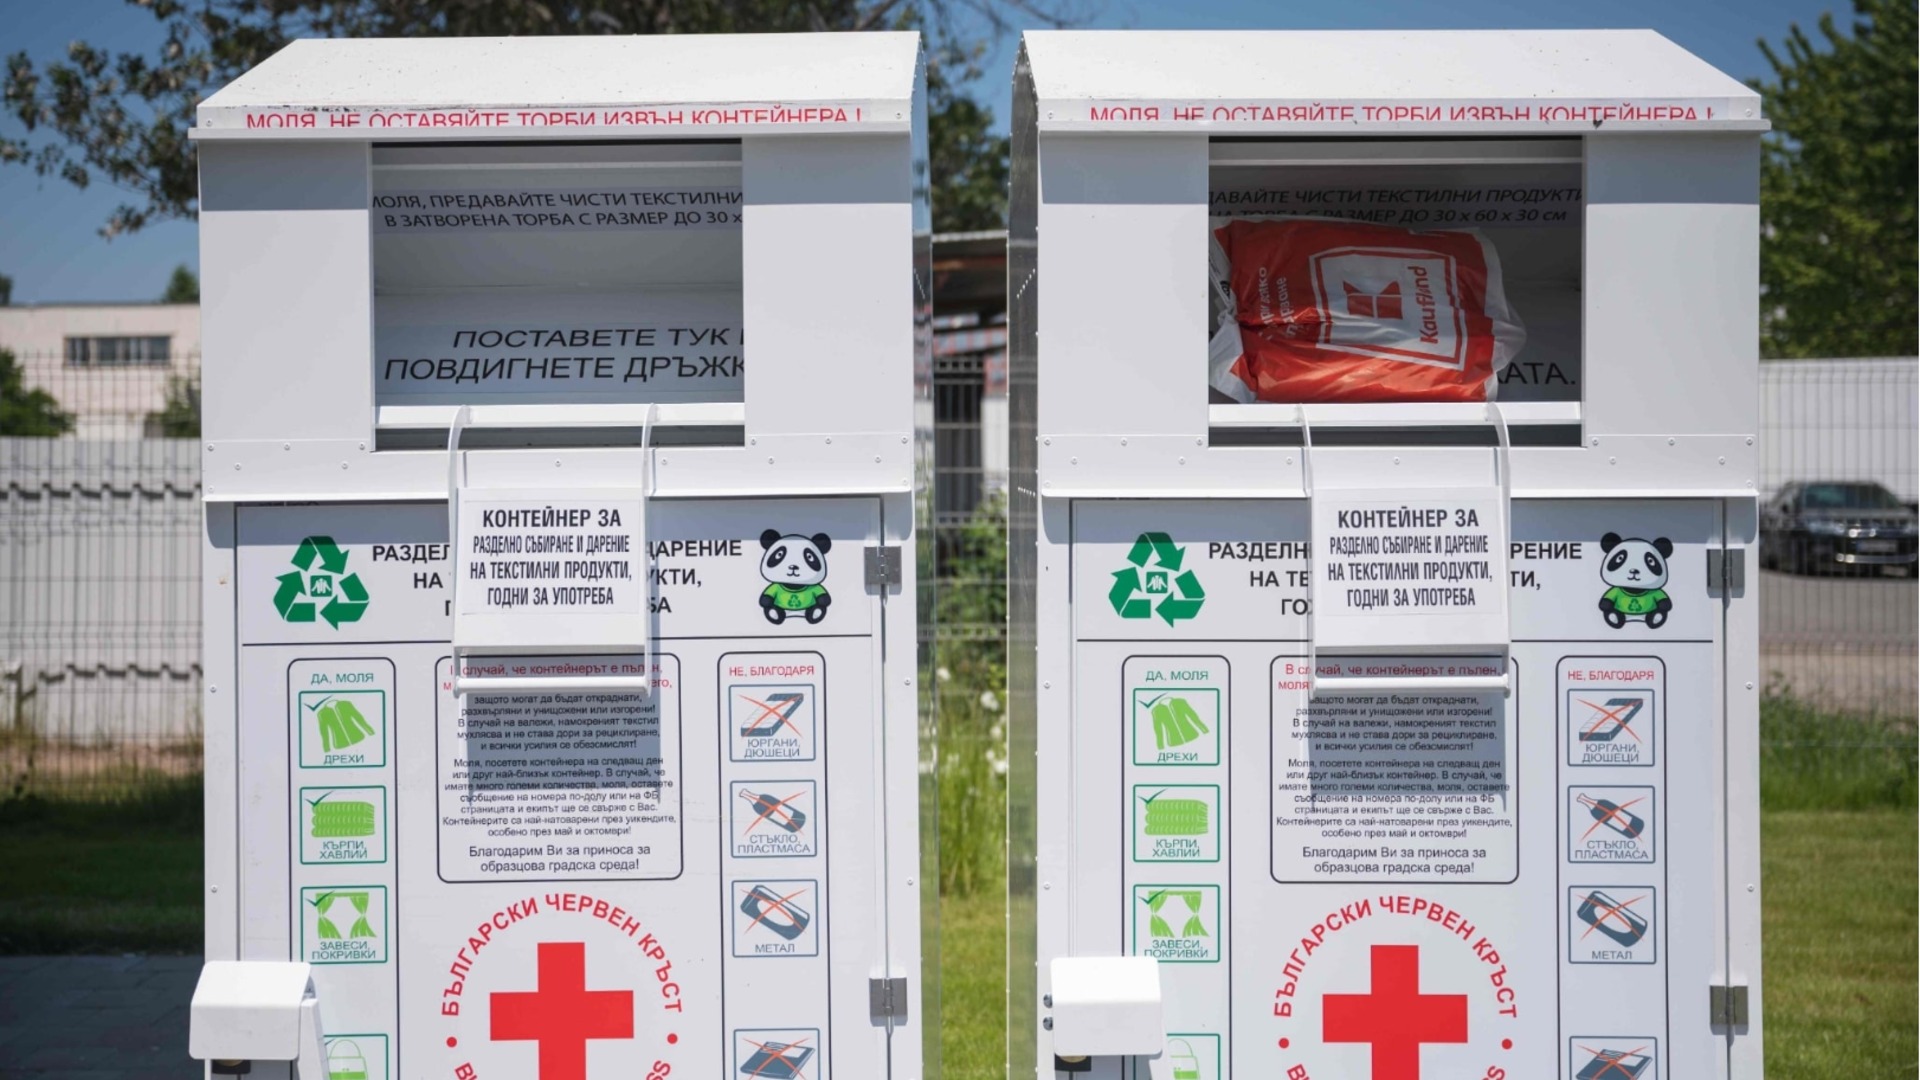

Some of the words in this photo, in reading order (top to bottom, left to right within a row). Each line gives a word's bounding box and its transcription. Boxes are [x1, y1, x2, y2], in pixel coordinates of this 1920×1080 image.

[431, 192, 554, 210] ПРЕДАВАЙТЕ
[562, 193, 626, 206] ЧИСТИ
[1295, 190, 1361, 204] ЧИСТИ
[1367, 189, 1482, 204] ТЕКСТИЛНИ
[386, 215, 396, 227] В
[402, 214, 509, 227] ЗАТВОРЕНА
[516, 213, 575, 226] ТОРБА
[580, 212, 592, 225] С
[596, 212, 668, 225] РАЗМЕР
[674, 212, 701, 226] ДО
[707, 212, 728, 224] 30
[1398, 208, 1430, 224] ДО
[1434, 209, 1456, 222] 30
[1476, 209, 1498, 222] 60
[1517, 209, 1538, 222] 30
[453, 329, 656, 348] ПОСТАВЕТЕ
[668, 328, 730, 346] ТУК
[384, 357, 615, 384] ПОВДИГНЕТЕ
[482, 506, 591, 528] КОНТЕЙНЕР
[598, 509, 622, 527] ЗА
[1338, 506, 1448, 528] КОНТЕЙНЕР
[1455, 509, 1479, 528] ЗА
[473, 536, 522, 556] РАЗДЕЛНО
[524, 535, 574, 553] СЪБИРАНЕ
[577, 535, 584, 552] И
[586, 535, 630, 554] ДАРЕНИЕ
[1330, 536, 1379, 558] РАЗДЕЛНО
[1382, 536, 1432, 554] СЪБИРАНЕ
[1435, 536, 1442, 552] И
[1444, 535, 1488, 555] ДАРЕНИЕ
[470, 562, 486, 580] НА
[490, 561, 560, 580] ТЕКСТИЛНИ
[564, 560, 632, 582] ПРОДУКТИ,
[1328, 564, 1344, 581] НА
[1348, 562, 1420, 581] ТЕКСТИЛНИ
[1424, 561, 1492, 582] ПРОДУКТИ,
[413, 572, 444, 589] НА
[1250, 571, 1280, 588] НА
[488, 588, 528, 608] ГОДНИ
[533, 588, 548, 605] ЗА
[553, 586, 614, 606] УПОТРЕБА
[1347, 590, 1390, 610] ГОДНИ
[1393, 588, 1410, 606] ЗА
[1413, 588, 1476, 606] УПОТРЕБА
[622, 664, 663, 674] пълн,
[729, 666, 748, 678] НЕ,
[750, 666, 815, 677] БЛАГОДАРЯ
[336, 672, 374, 683] МОЛЯ
[1170, 670, 1209, 681] МОЛЯ
[1568, 670, 1586, 682] НЕ,
[1588, 670, 1655, 682] БЛАГОДАРЯ
[744, 748, 801, 759] ДЮШЕЦИ
[1586, 743, 1640, 755] ЮРГАНИ,
[324, 754, 364, 766] ДРЕХИ
[1157, 752, 1198, 764] ДРЕХИ
[1582, 752, 1640, 764] ДЮШЕЦИ
[323, 840, 368, 852] КЪРПИ,
[750, 834, 800, 846] СТЪКЛО,
[1156, 838, 1200, 850] КЪРПИ,
[1586, 840, 1639, 852] СТЪКЛО,
[320, 850, 368, 860] ХАВЛИИ
[469, 845, 542, 860] Благодарим
[547, 845, 563, 856] Ви
[566, 848, 580, 856] за
[584, 846, 634, 858] приноса
[638, 846, 650, 856] за
[738, 844, 810, 855] ПЛАСТМАСА
[1152, 848, 1200, 858] ХАВЛИИ
[1302, 846, 1378, 861] Благодарим
[1381, 846, 1398, 858] Ви
[1401, 849, 1414, 858] за
[1418, 849, 1469, 860] приноса
[1472, 849, 1486, 858] за
[1574, 850, 1648, 860] ПЛАСТМАСА
[480, 860, 545, 873] образцова
[549, 860, 596, 872] градска
[600, 859, 640, 872] среда!
[1314, 861, 1380, 875] образцова
[1383, 862, 1431, 874] градска
[1434, 862, 1474, 874] среда!
[320, 940, 370, 952] ЗАВЕСИ,
[755, 943, 796, 954] МЕТАЛ
[1152, 940, 1203, 952] ЗАВЕСИ,
[312, 950, 376, 960] ПОКРИВКИ
[442, 898, 538, 1016] БЪЛГАРСКИ
[545, 893, 640, 936] ЧЕРВЕН
[638, 933, 682, 1013] КРЪСТ
[1144, 948, 1208, 959] ПОКРИВКИ
[1274, 899, 1372, 1017] БЪЛГАРСКИ
[1379, 896, 1476, 940] ЧЕРВЕН
[1472, 938, 1517, 1018] КРЪСТ
[1592, 950, 1632, 960] МЕТАЛ
